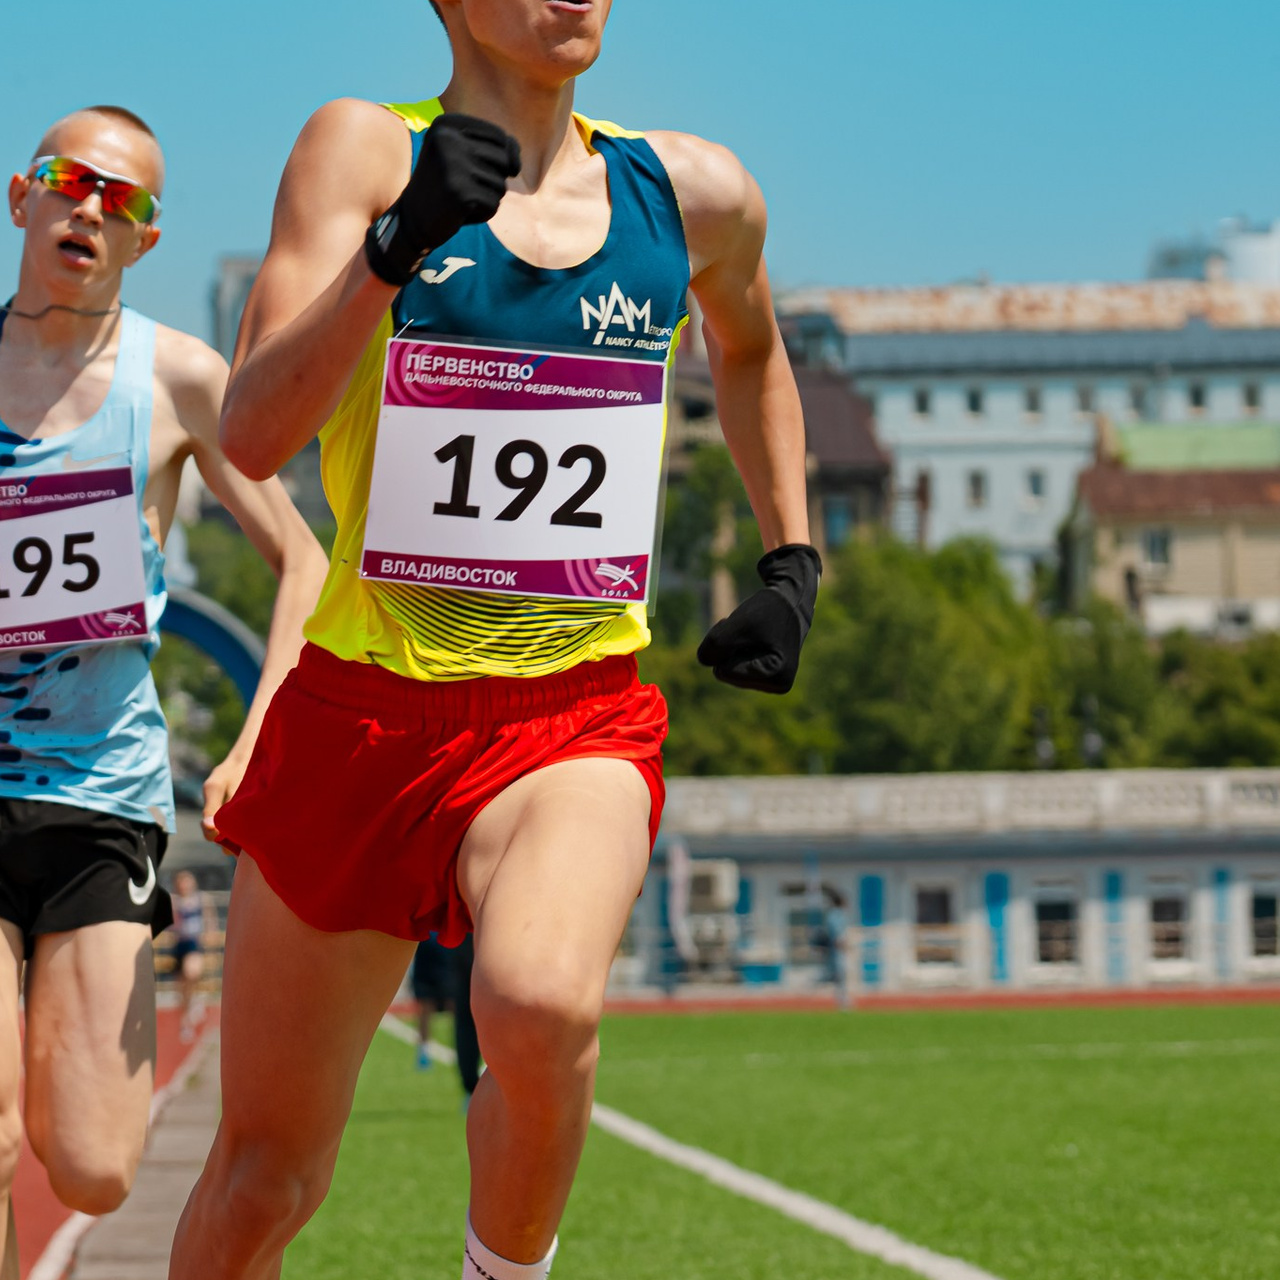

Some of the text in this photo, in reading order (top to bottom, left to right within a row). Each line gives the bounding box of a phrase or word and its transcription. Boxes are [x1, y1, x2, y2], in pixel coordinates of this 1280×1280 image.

[405, 353, 534, 380] ПЕРВЕНСТВО
[403, 372, 643, 402] ДАЛЬНЕВОСТОЧНОГО ФЕДЕРАЛЬНОГО ОКРУГА
[433, 434, 607, 529] 192
[379, 558, 519, 587] ВЛАДИВОСТОК
